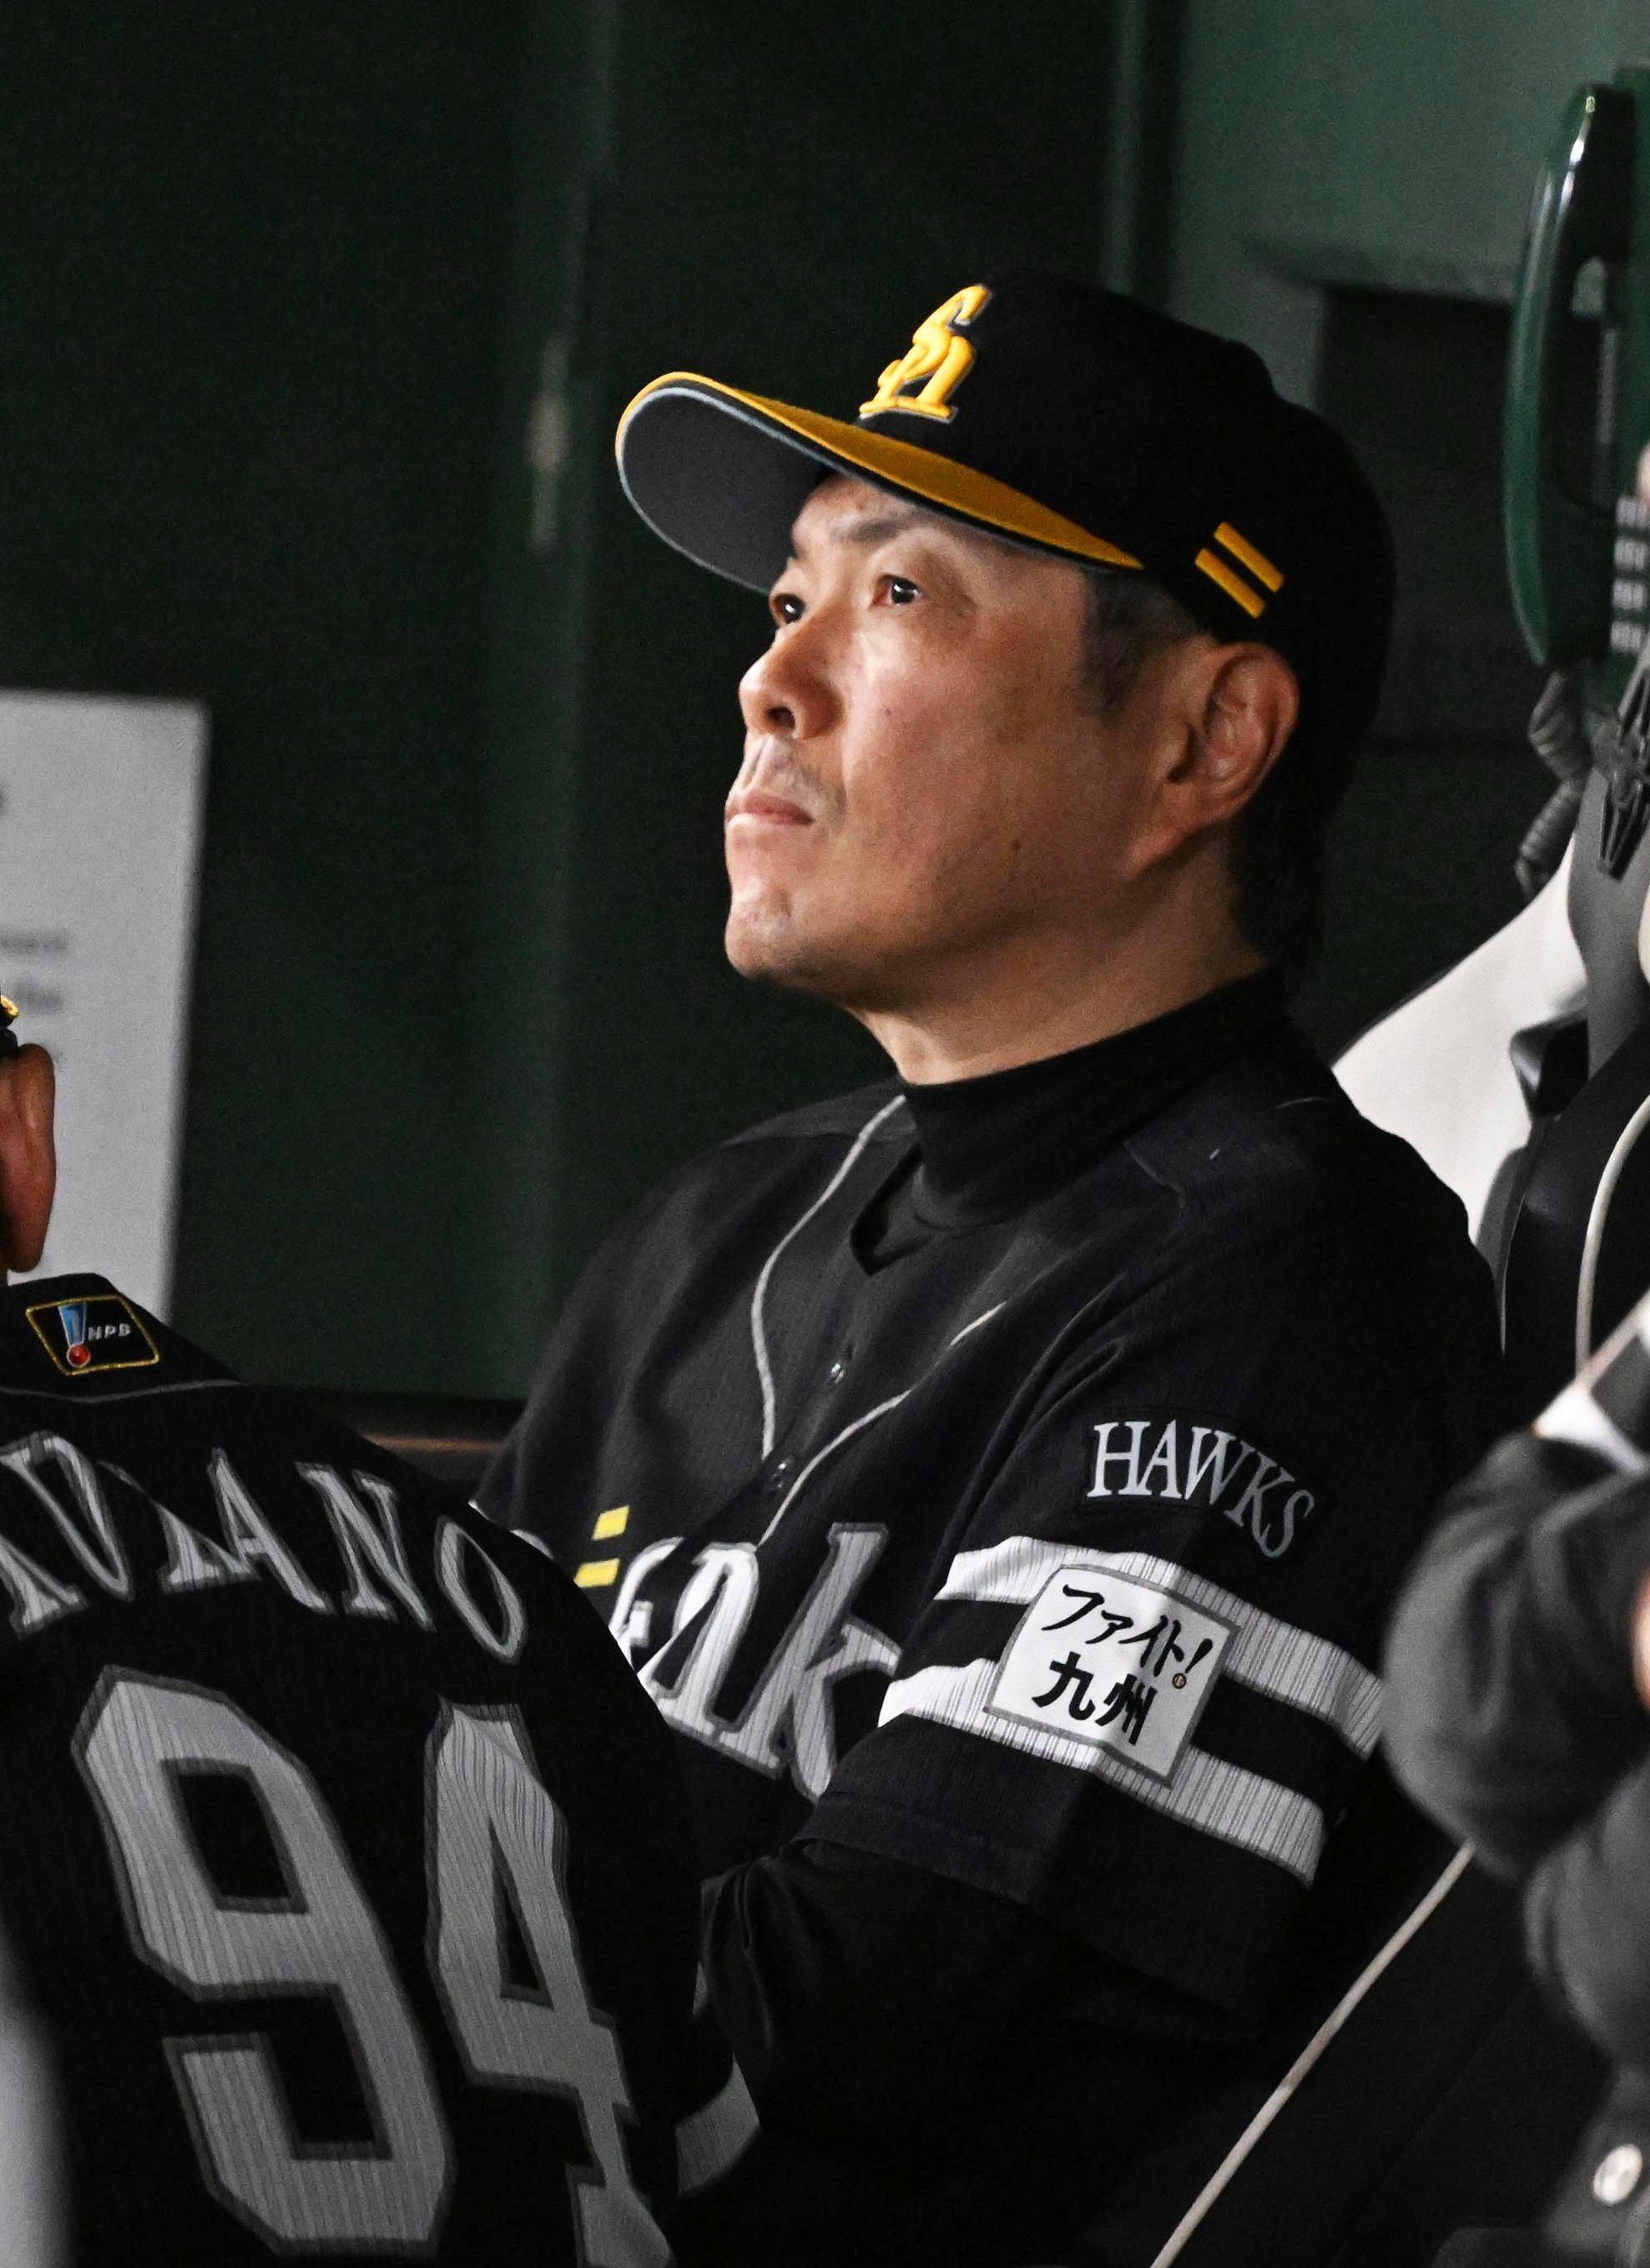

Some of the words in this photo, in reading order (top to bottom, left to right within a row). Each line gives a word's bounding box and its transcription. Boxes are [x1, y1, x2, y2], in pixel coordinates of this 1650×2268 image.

[88, 1323, 131, 1342] NPB
[1087, 1419, 1315, 1558] HAWKS
[1031, 1651, 1158, 1746] 九州
[70, 1663, 678, 2268] 94
